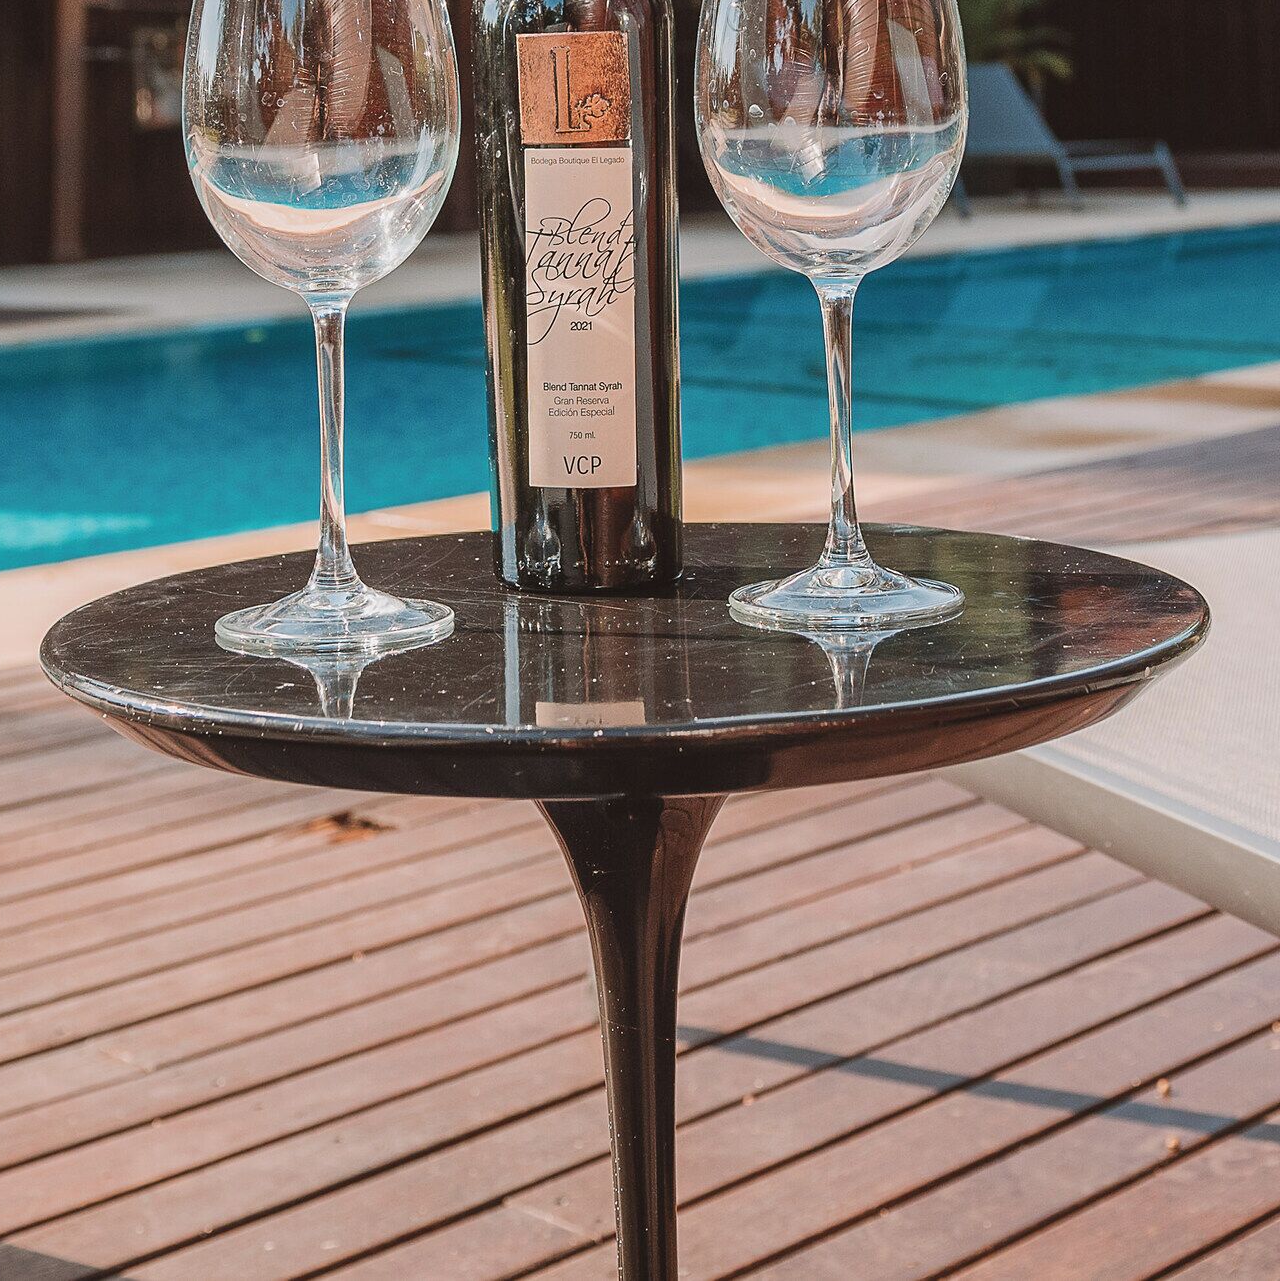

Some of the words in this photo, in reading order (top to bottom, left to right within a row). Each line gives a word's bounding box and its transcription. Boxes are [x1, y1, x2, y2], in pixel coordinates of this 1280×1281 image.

[530, 156, 558, 167] Bodega
[558, 156, 590, 166] Boutique
[591, 156, 599, 164] El
[600, 156, 625, 165] Legado
[539, 197, 634, 254] Blend
[525, 228, 635, 294] Tannat
[525, 264, 633, 346] Syrah
[570, 321, 593, 331] 2021
[543, 382, 567, 392] Blend
[569, 382, 597, 392] Tannat
[598, 381, 623, 392] Syrah
[553, 396, 574, 405] Gran
[576, 396, 610, 405] Reserva
[548, 407, 578, 417] Edición
[580, 405, 615, 418] Especial
[569, 431, 583, 439] 750
[563, 455, 602, 475] VCP
